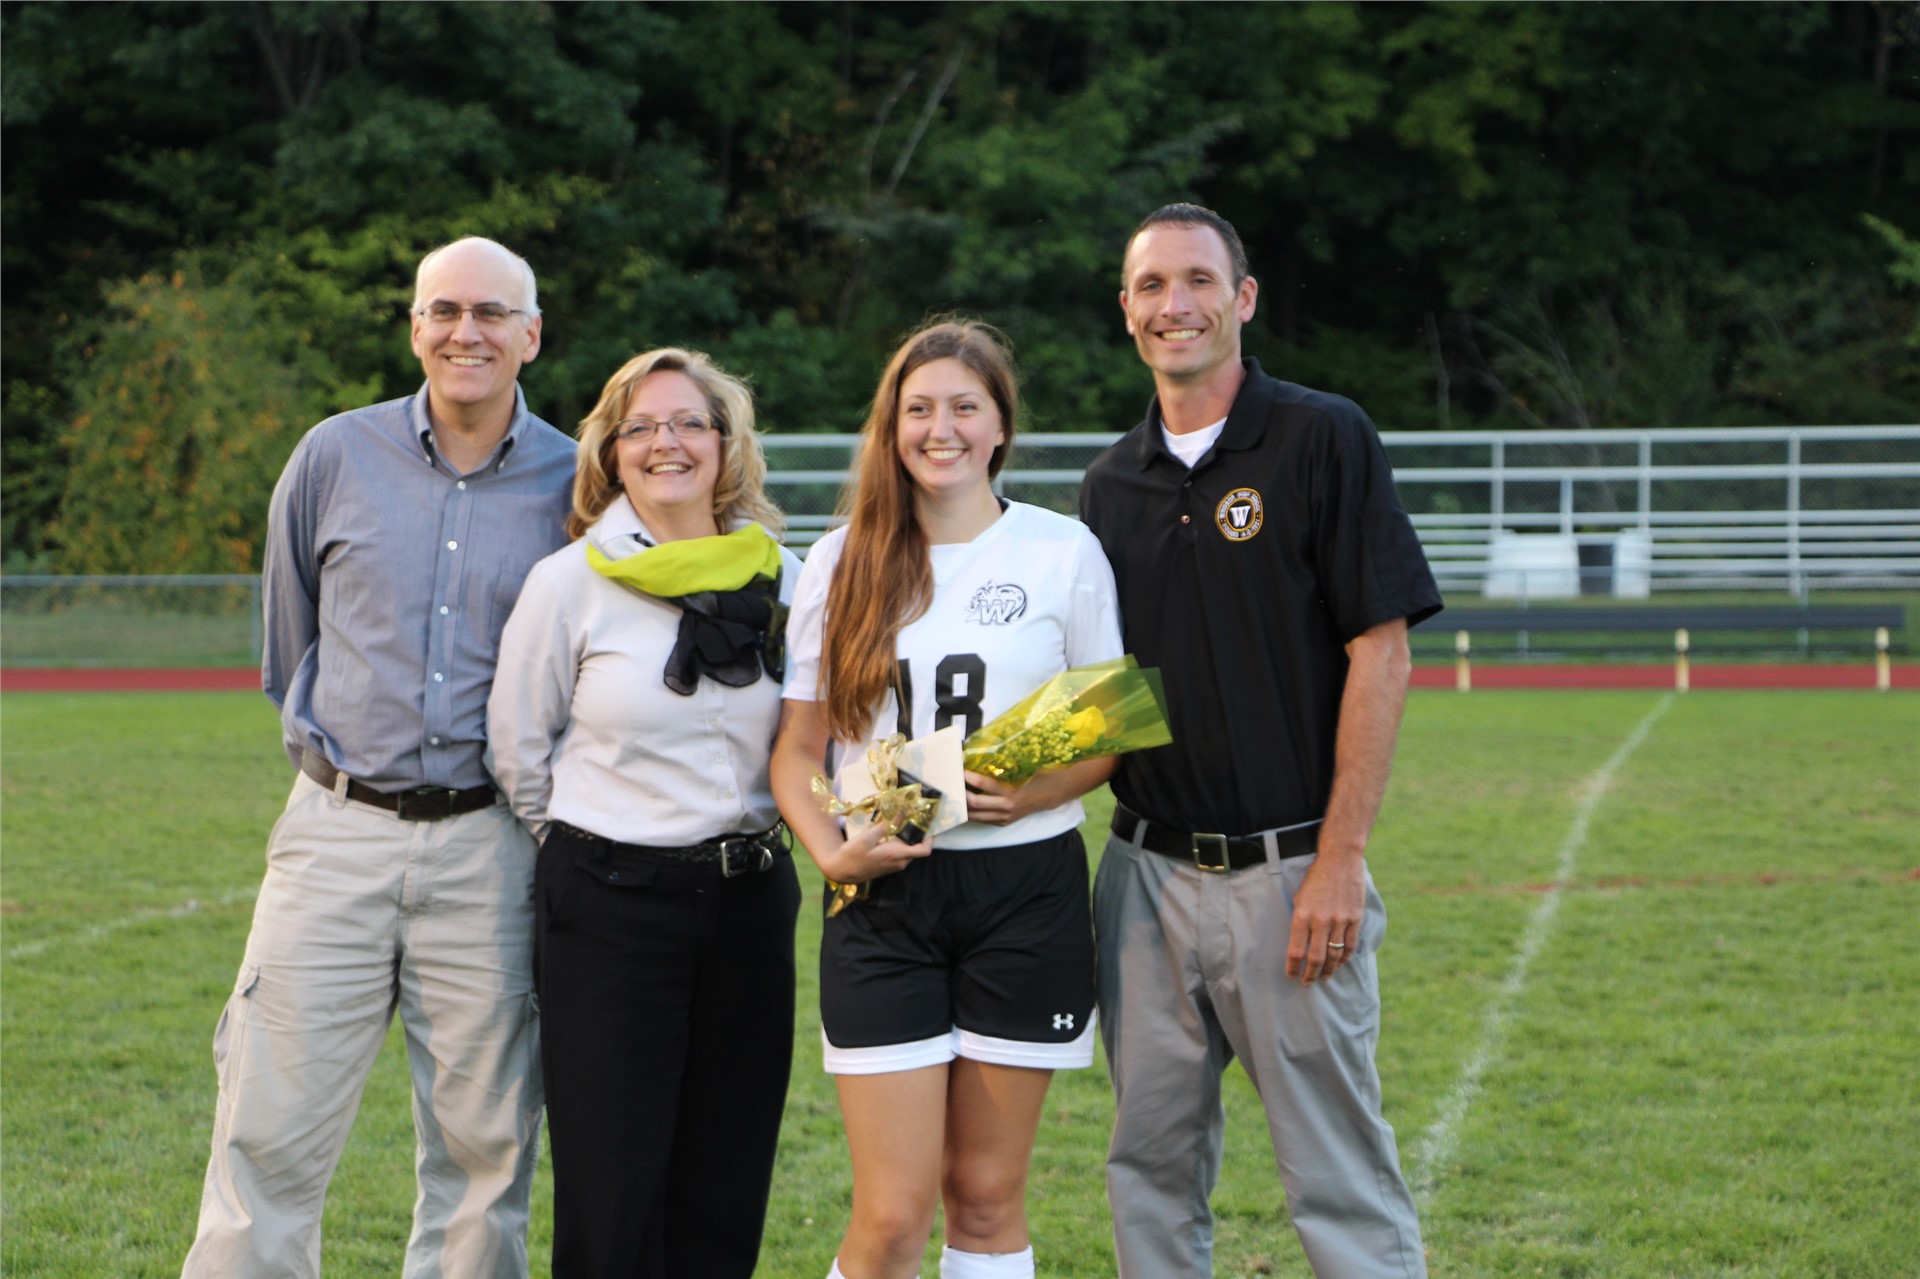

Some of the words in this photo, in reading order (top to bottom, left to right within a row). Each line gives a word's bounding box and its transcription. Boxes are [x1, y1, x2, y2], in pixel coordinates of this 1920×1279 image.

[1229, 505, 1251, 528] W
[979, 599, 1017, 625] W
[888, 653, 987, 744] 18
